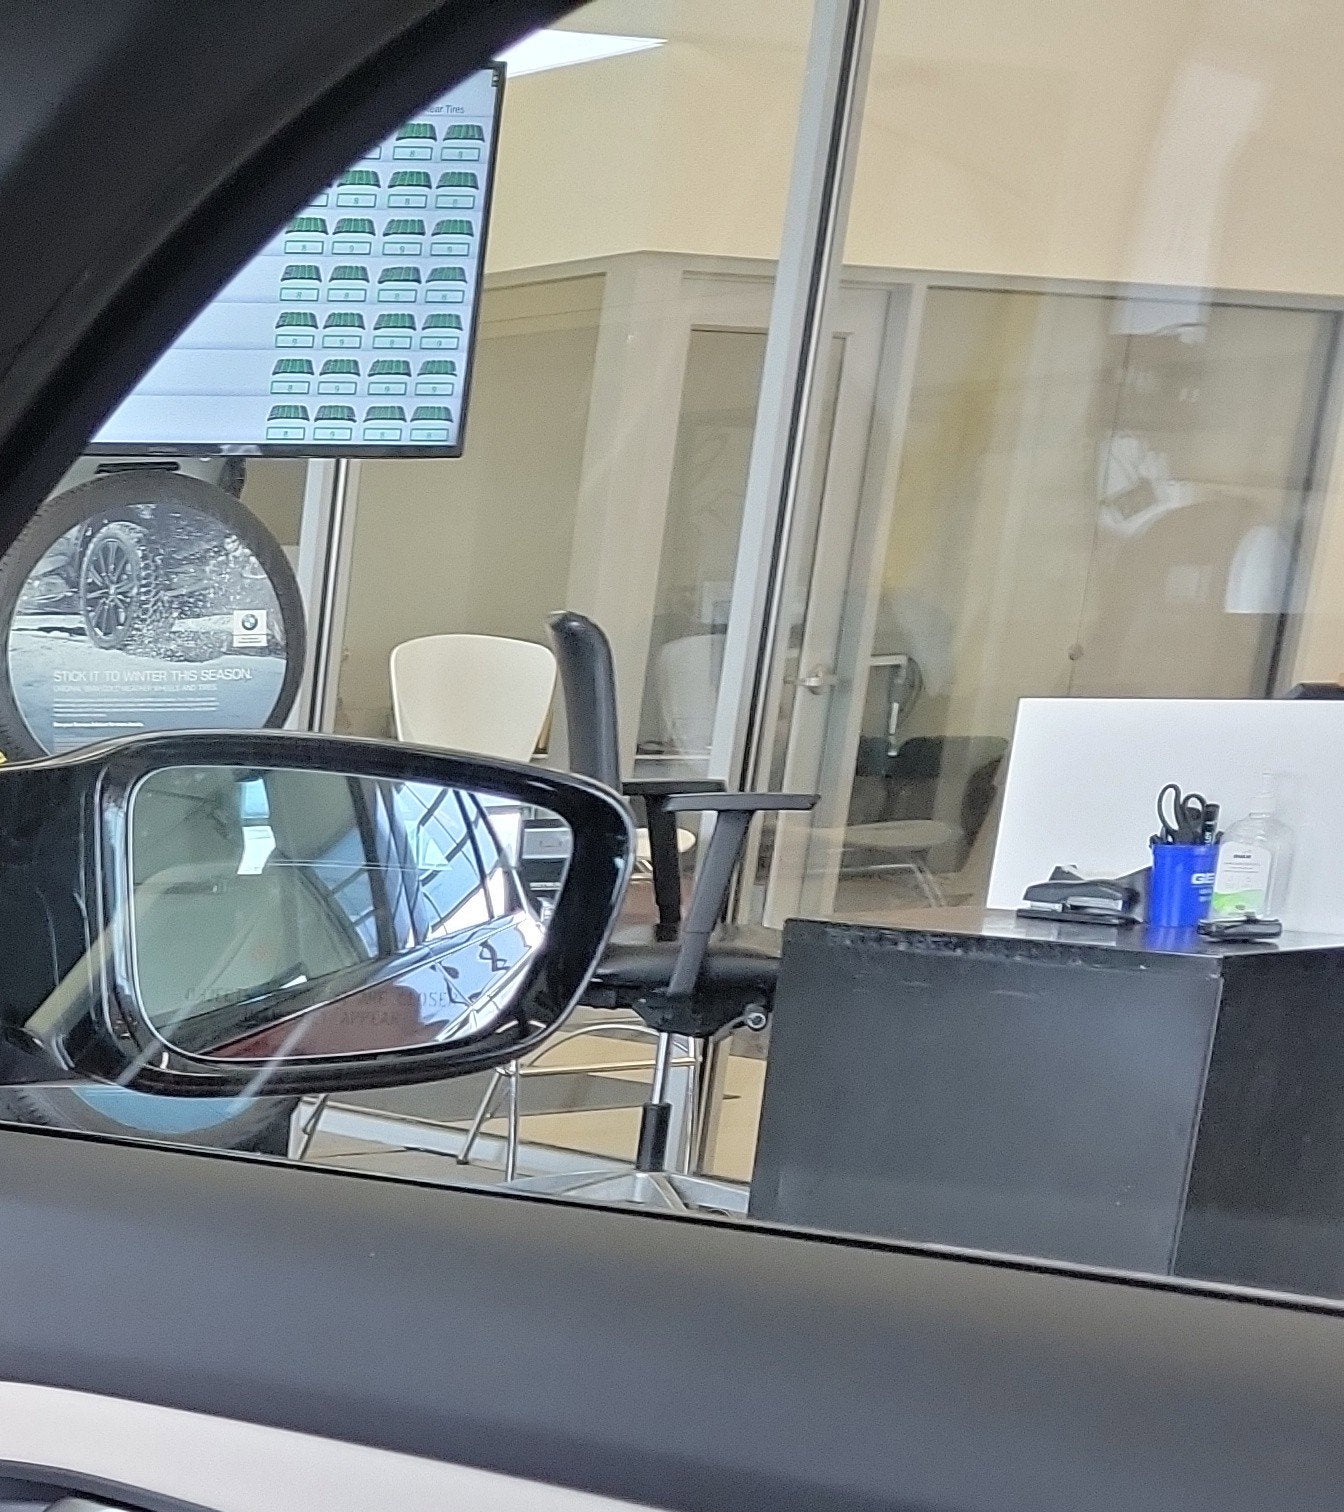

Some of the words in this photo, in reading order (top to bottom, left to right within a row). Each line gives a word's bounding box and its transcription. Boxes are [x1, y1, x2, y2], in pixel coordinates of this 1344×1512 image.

[446, 105, 464, 114] Tires
[105, 670, 119, 681] TO
[124, 670, 167, 681] WINTER
[171, 669, 197, 681] THIS
